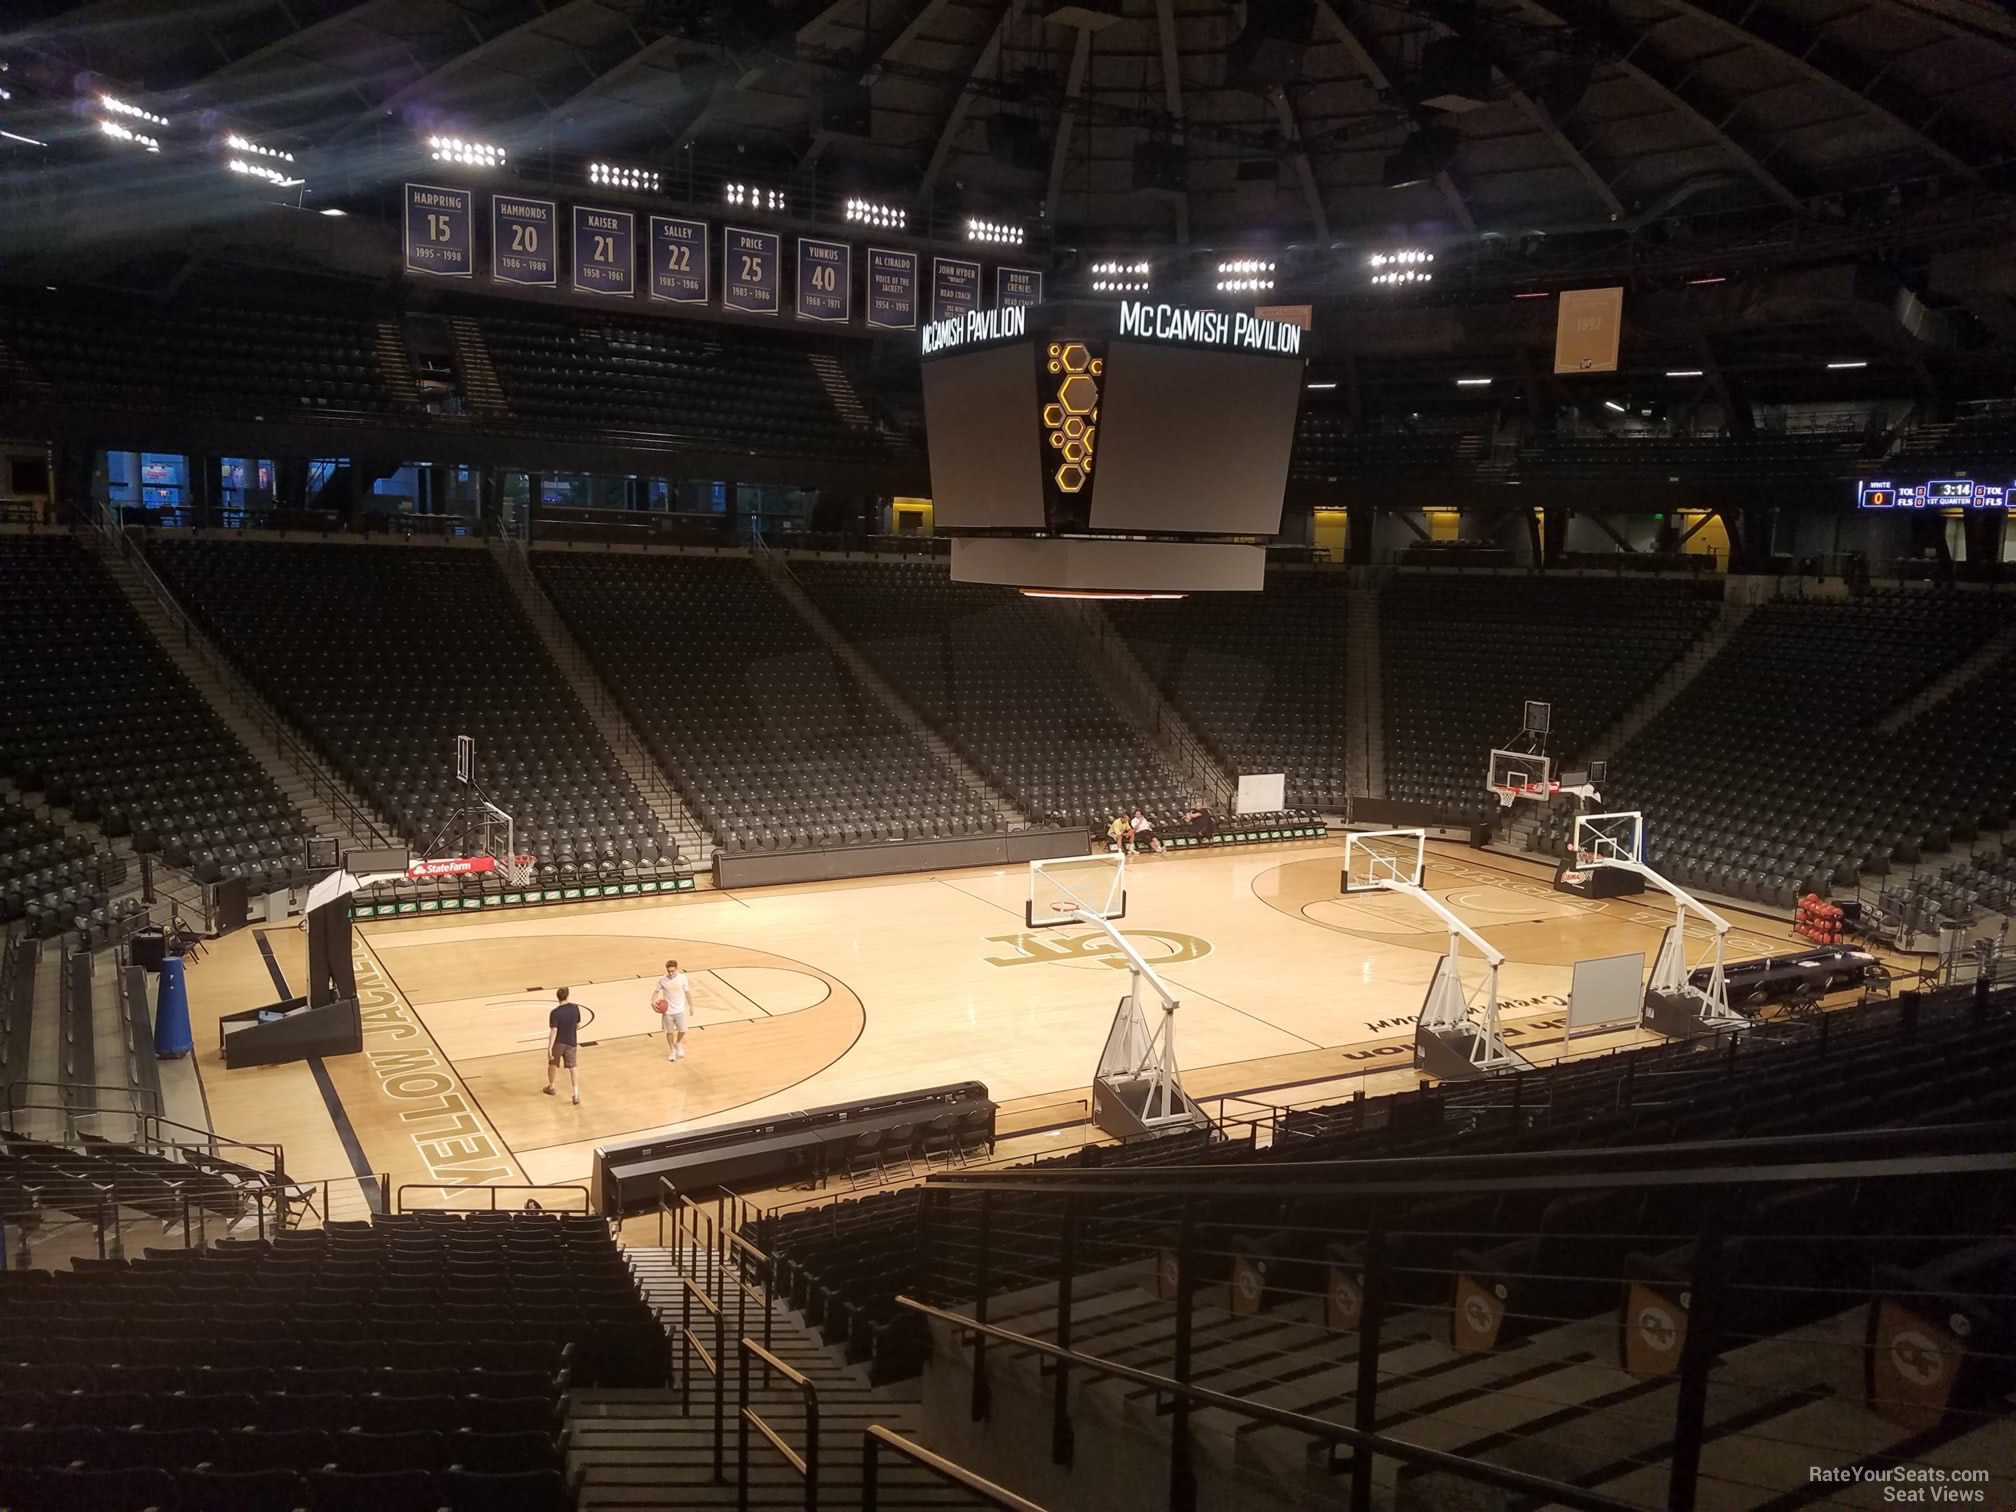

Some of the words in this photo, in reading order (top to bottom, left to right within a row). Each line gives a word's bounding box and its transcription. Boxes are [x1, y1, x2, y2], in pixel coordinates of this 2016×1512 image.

[414, 191, 462, 209] HARPRING
[501, 203, 547, 220] HAMMONDS
[427, 214, 451, 242] 15
[588, 215, 618, 230] KAISER
[512, 224, 538, 253] 20
[664, 225, 693, 239] SALLEY
[594, 235, 614, 263] 21
[741, 237, 763, 250] PRICE
[416, 247, 435, 259] 1995
[443, 250, 462, 262] 1998
[668, 244, 690, 272] 22
[809, 246, 839, 261] YUNKUS
[502, 257, 520, 269] 1986
[529, 260, 547, 272] 1989
[741, 255, 762, 282] 25
[874, 256, 883, 266] AL
[884, 257, 911, 269] CIRALDO
[583, 267, 600, 278] 1958
[608, 270, 624, 281] 1961
[811, 265, 835, 292] 40
[938, 264, 955, 276] JOHN
[955, 267, 976, 279] HYDER
[659, 276, 675, 287] 1983
[683, 279, 699, 290] 1986
[875, 274, 891, 284] VOICE
[892, 276, 899, 285] OF
[900, 277, 910, 287] THE
[1010, 274, 1030, 285] BOBBY
[732, 286, 748, 297] 1983
[755, 289, 770, 301] 1986
[881, 284, 904, 294] JACKETS
[806, 295, 821, 306] 1968
[828, 298, 841, 309] 1971
[967, 305, 1026, 343] PAVILION
[1234, 312, 1301, 355] PAVILION
[1899, 488, 1914, 496] TOL
[1943, 484, 1970, 496] 3:14
[1986, 487, 2004, 495] TOL
[1874, 492, 1883, 505] 0
[1898, 498, 1913, 506] FLS
[1985, 498, 2003, 506] FLS
[1363, 1015, 1420, 1033] ourt
[365, 1048, 513, 1200] YELLOW
